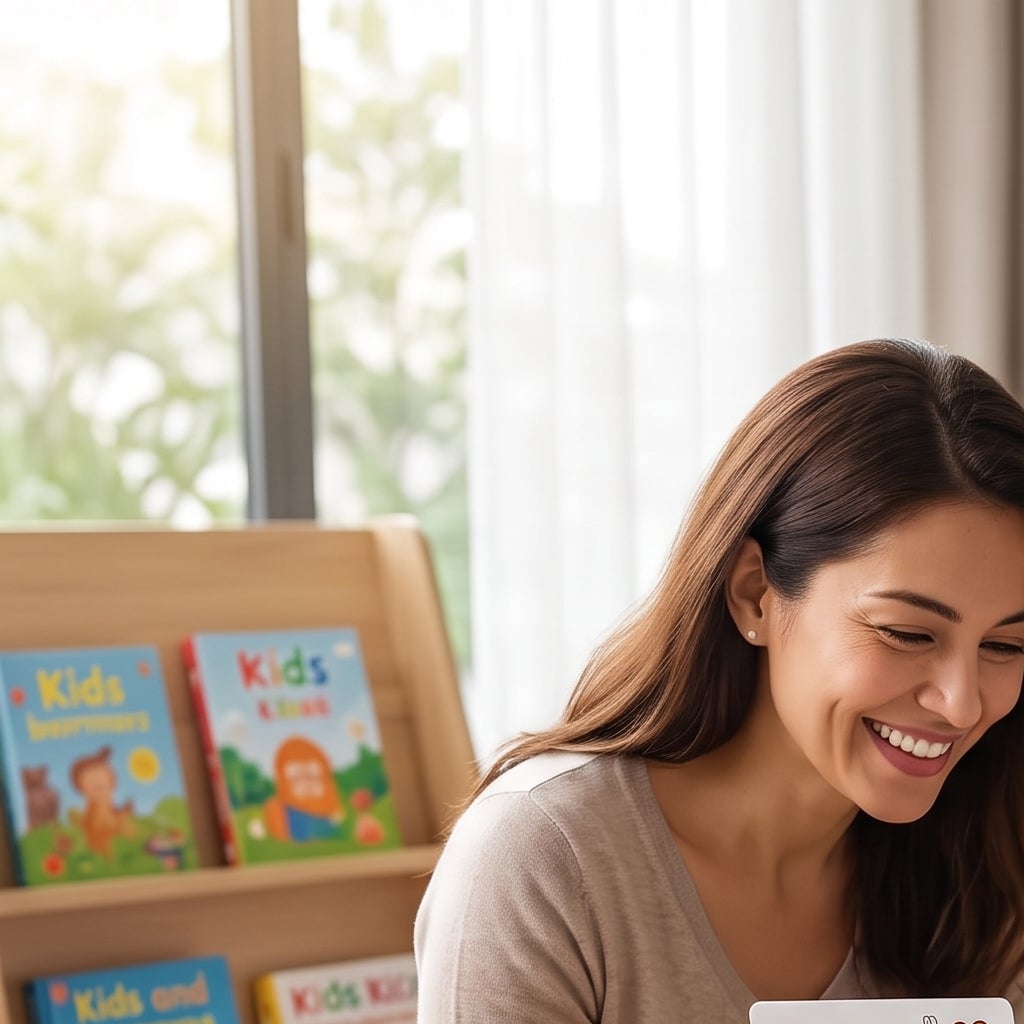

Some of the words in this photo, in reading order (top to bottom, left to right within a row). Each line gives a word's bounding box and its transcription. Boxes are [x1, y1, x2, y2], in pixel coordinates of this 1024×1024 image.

[37, 665, 125, 711] Kids
[234, 645, 328, 690] Kids
[74, 981, 143, 1023] Kids
